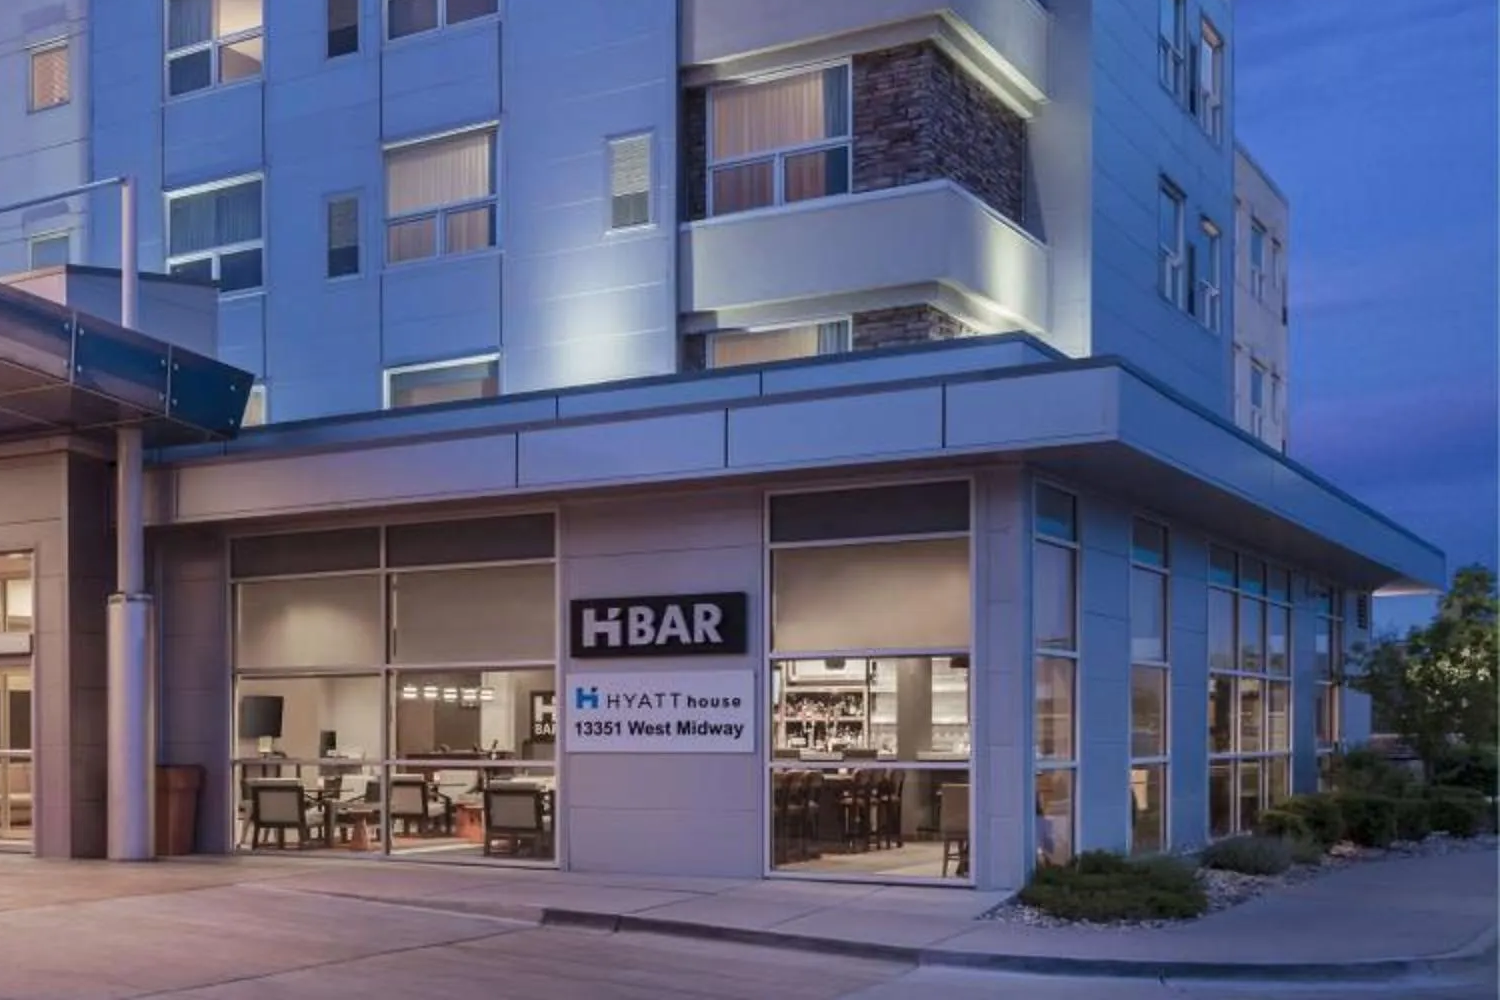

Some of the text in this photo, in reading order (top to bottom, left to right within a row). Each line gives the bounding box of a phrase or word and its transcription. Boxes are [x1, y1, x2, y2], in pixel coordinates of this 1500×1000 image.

[607, 693, 681, 709] HYATT
[687, 696, 741, 709] house
[575, 720, 744, 739] 13351 West Midway
